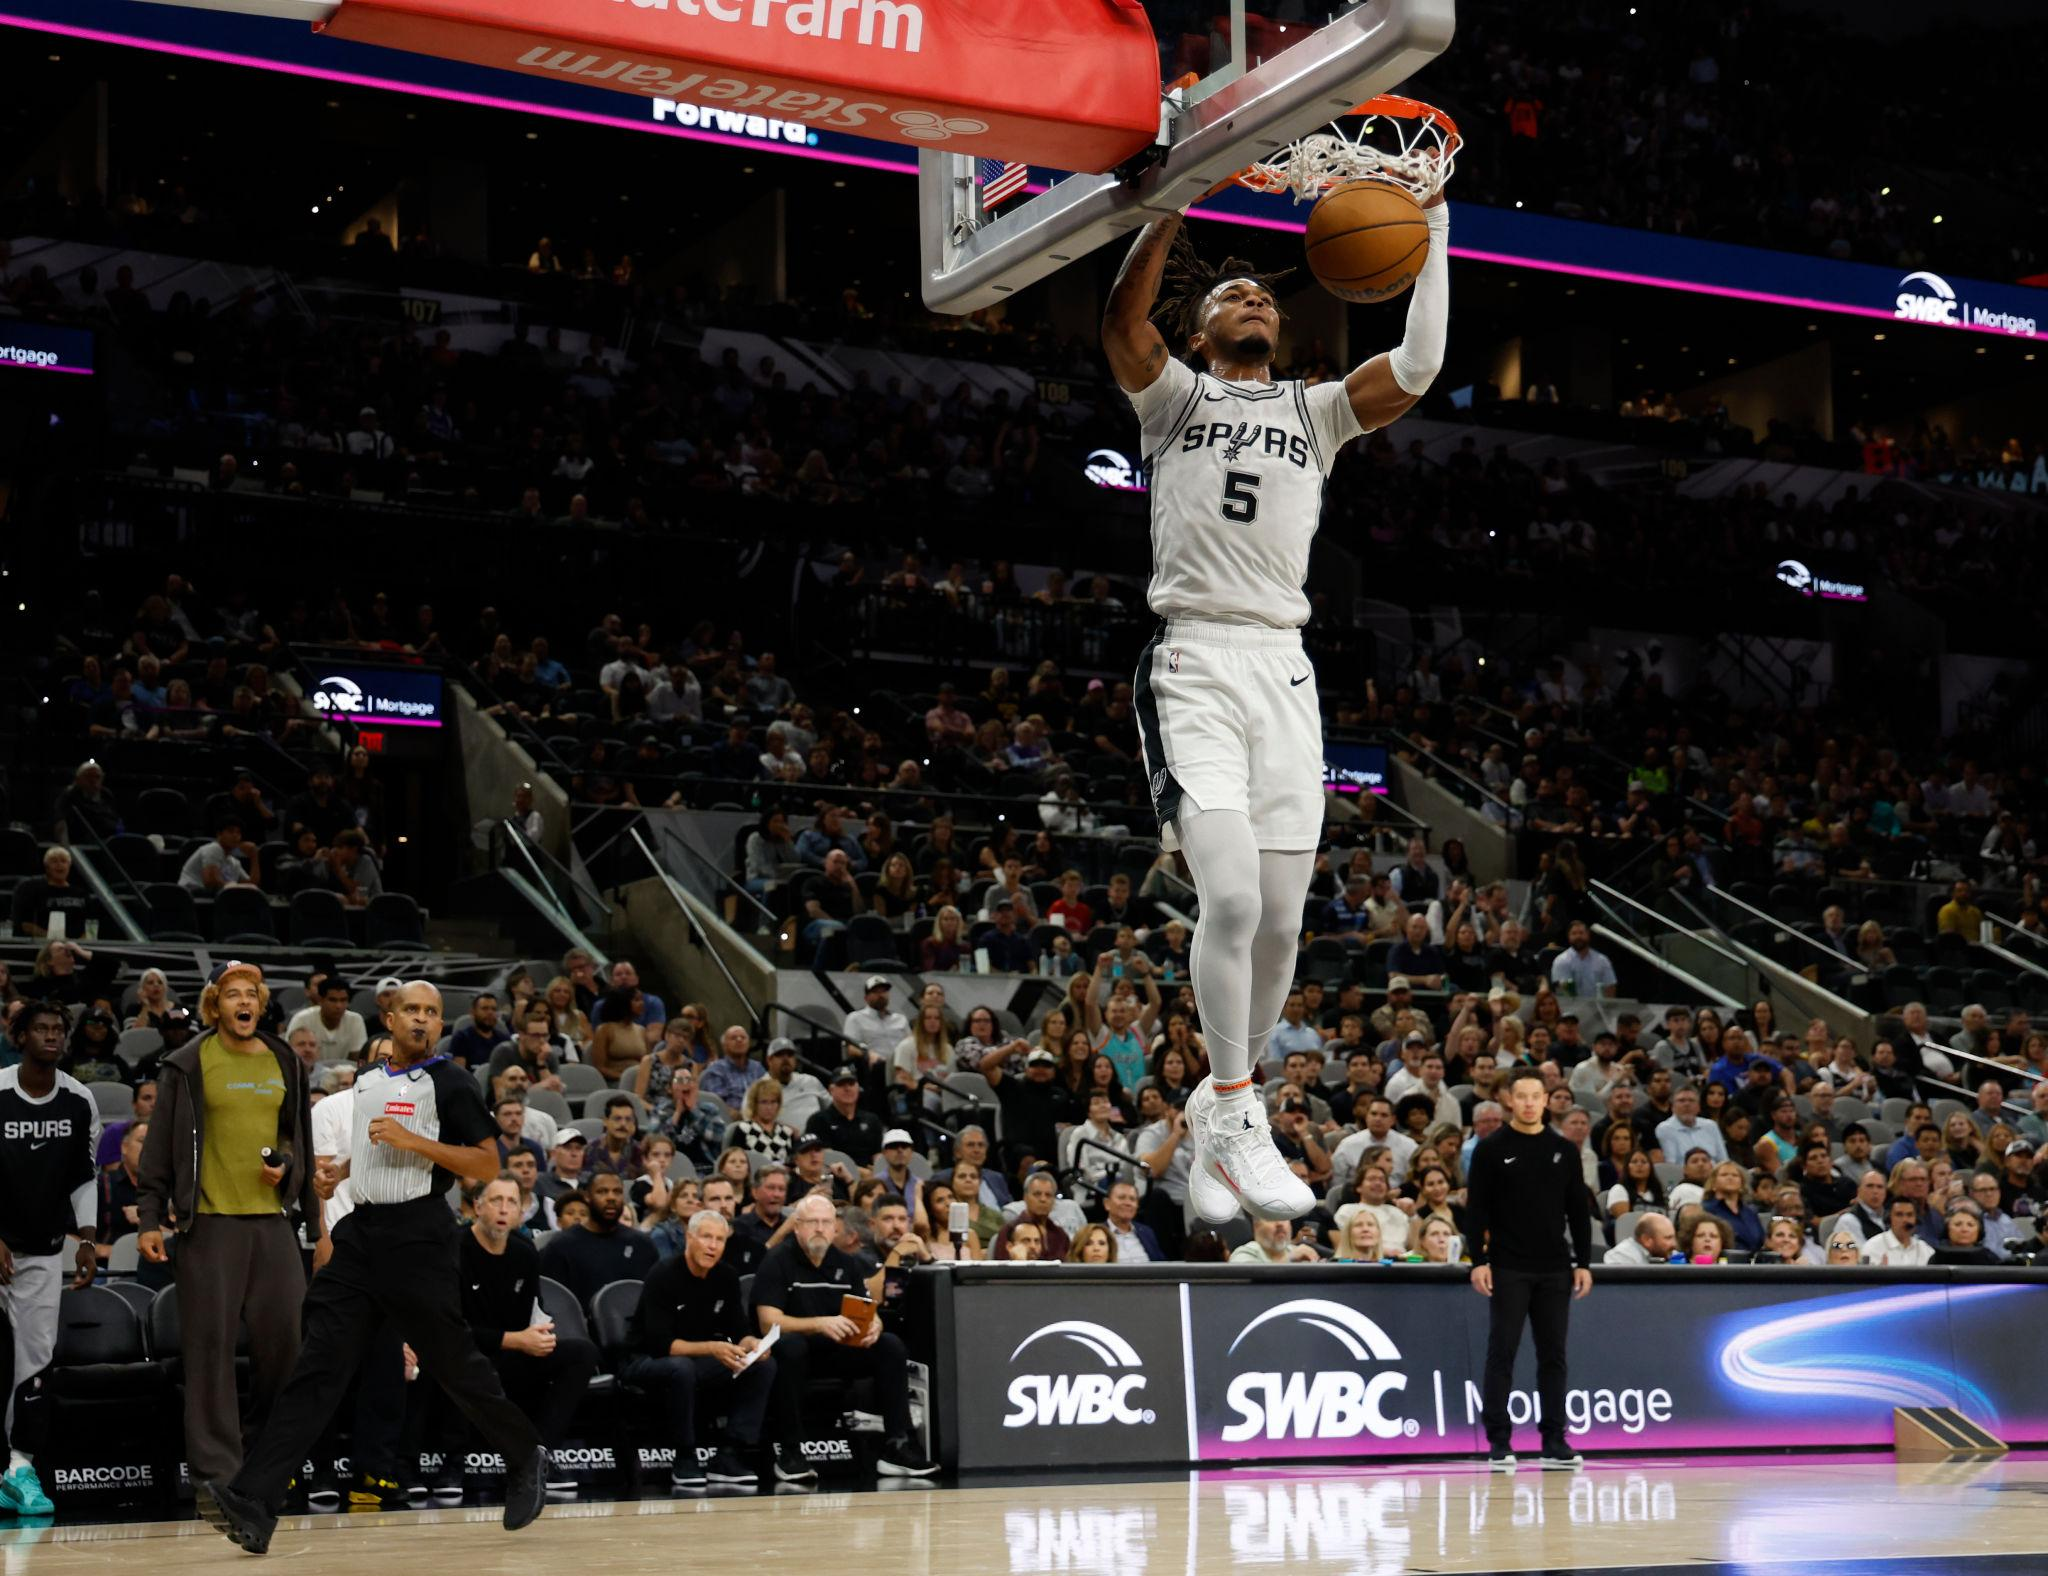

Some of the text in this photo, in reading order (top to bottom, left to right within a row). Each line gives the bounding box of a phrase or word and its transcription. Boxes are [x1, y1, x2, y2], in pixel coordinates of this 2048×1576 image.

[400, 299, 440, 323] 107
[1219, 468, 1262, 526] 5
[375, 697, 435, 717] Mortgage
[4, 1119, 73, 1139] SPURS
[54, 1464, 153, 1484] BARCODE
[55, 1479, 154, 1492] PERFORMANCE WATER
